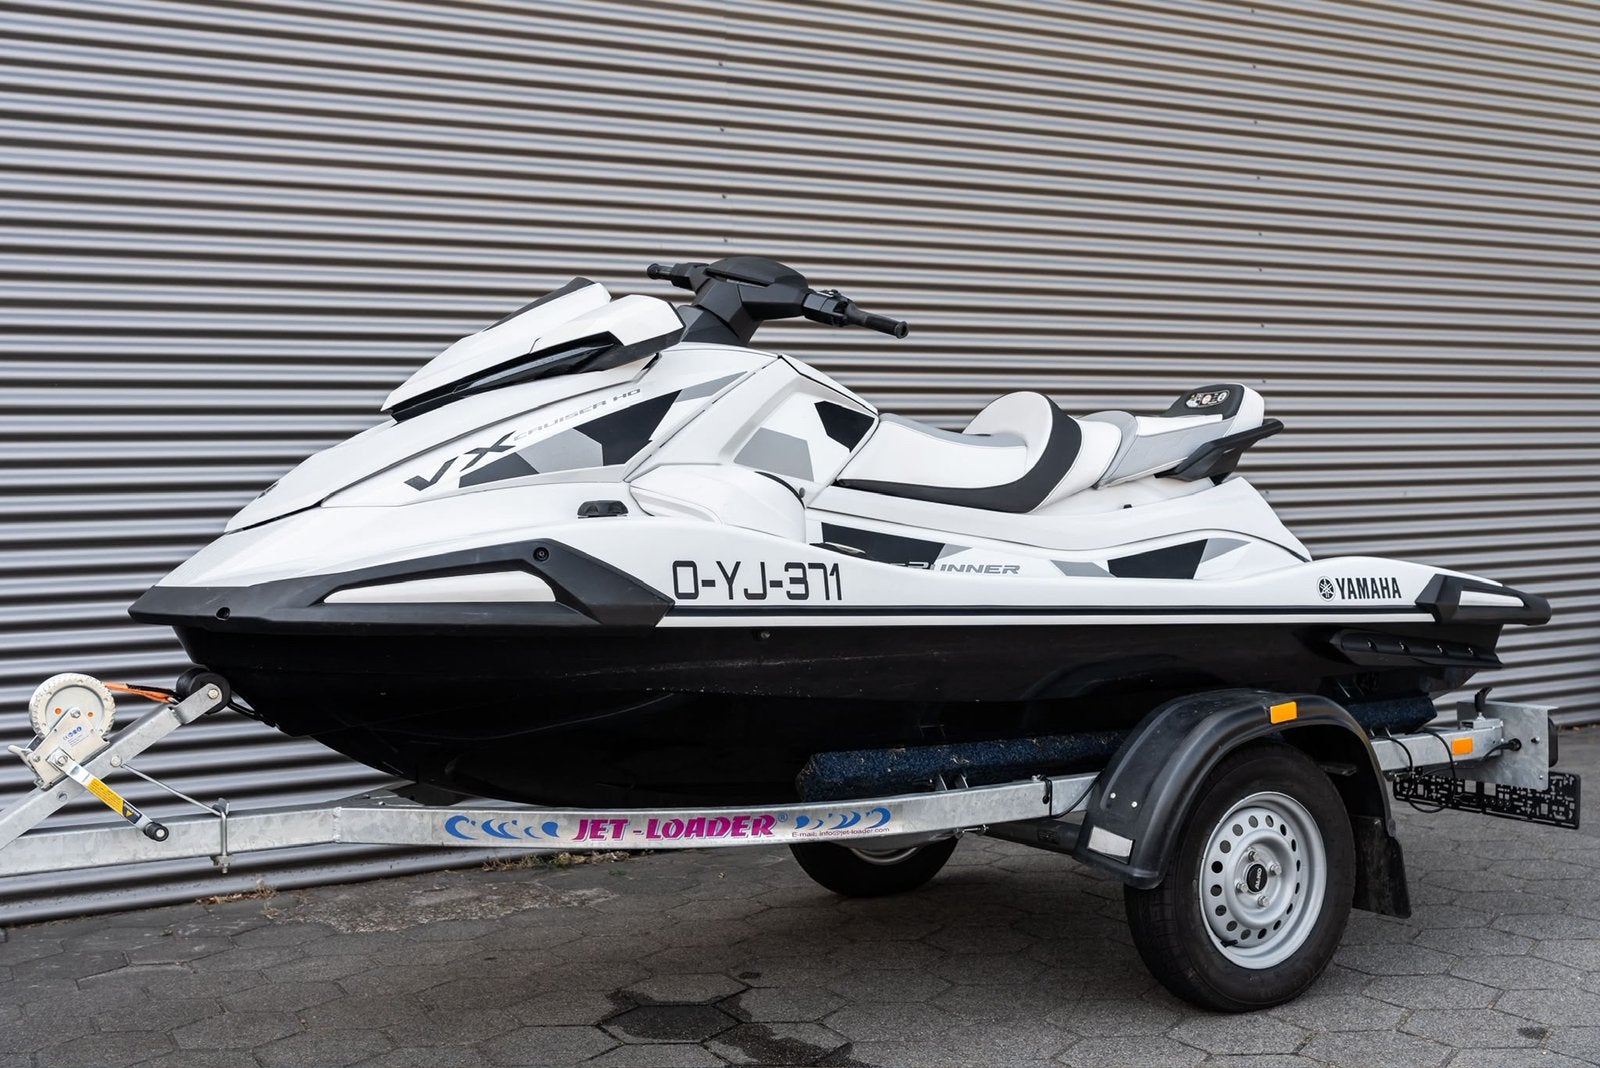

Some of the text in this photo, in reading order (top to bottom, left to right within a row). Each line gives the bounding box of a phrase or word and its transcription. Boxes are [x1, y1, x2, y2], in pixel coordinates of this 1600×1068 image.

[513, 400, 607, 442] CRUISER
[612, 388, 641, 402] HD
[1335, 577, 1402, 600] YAMAHA
